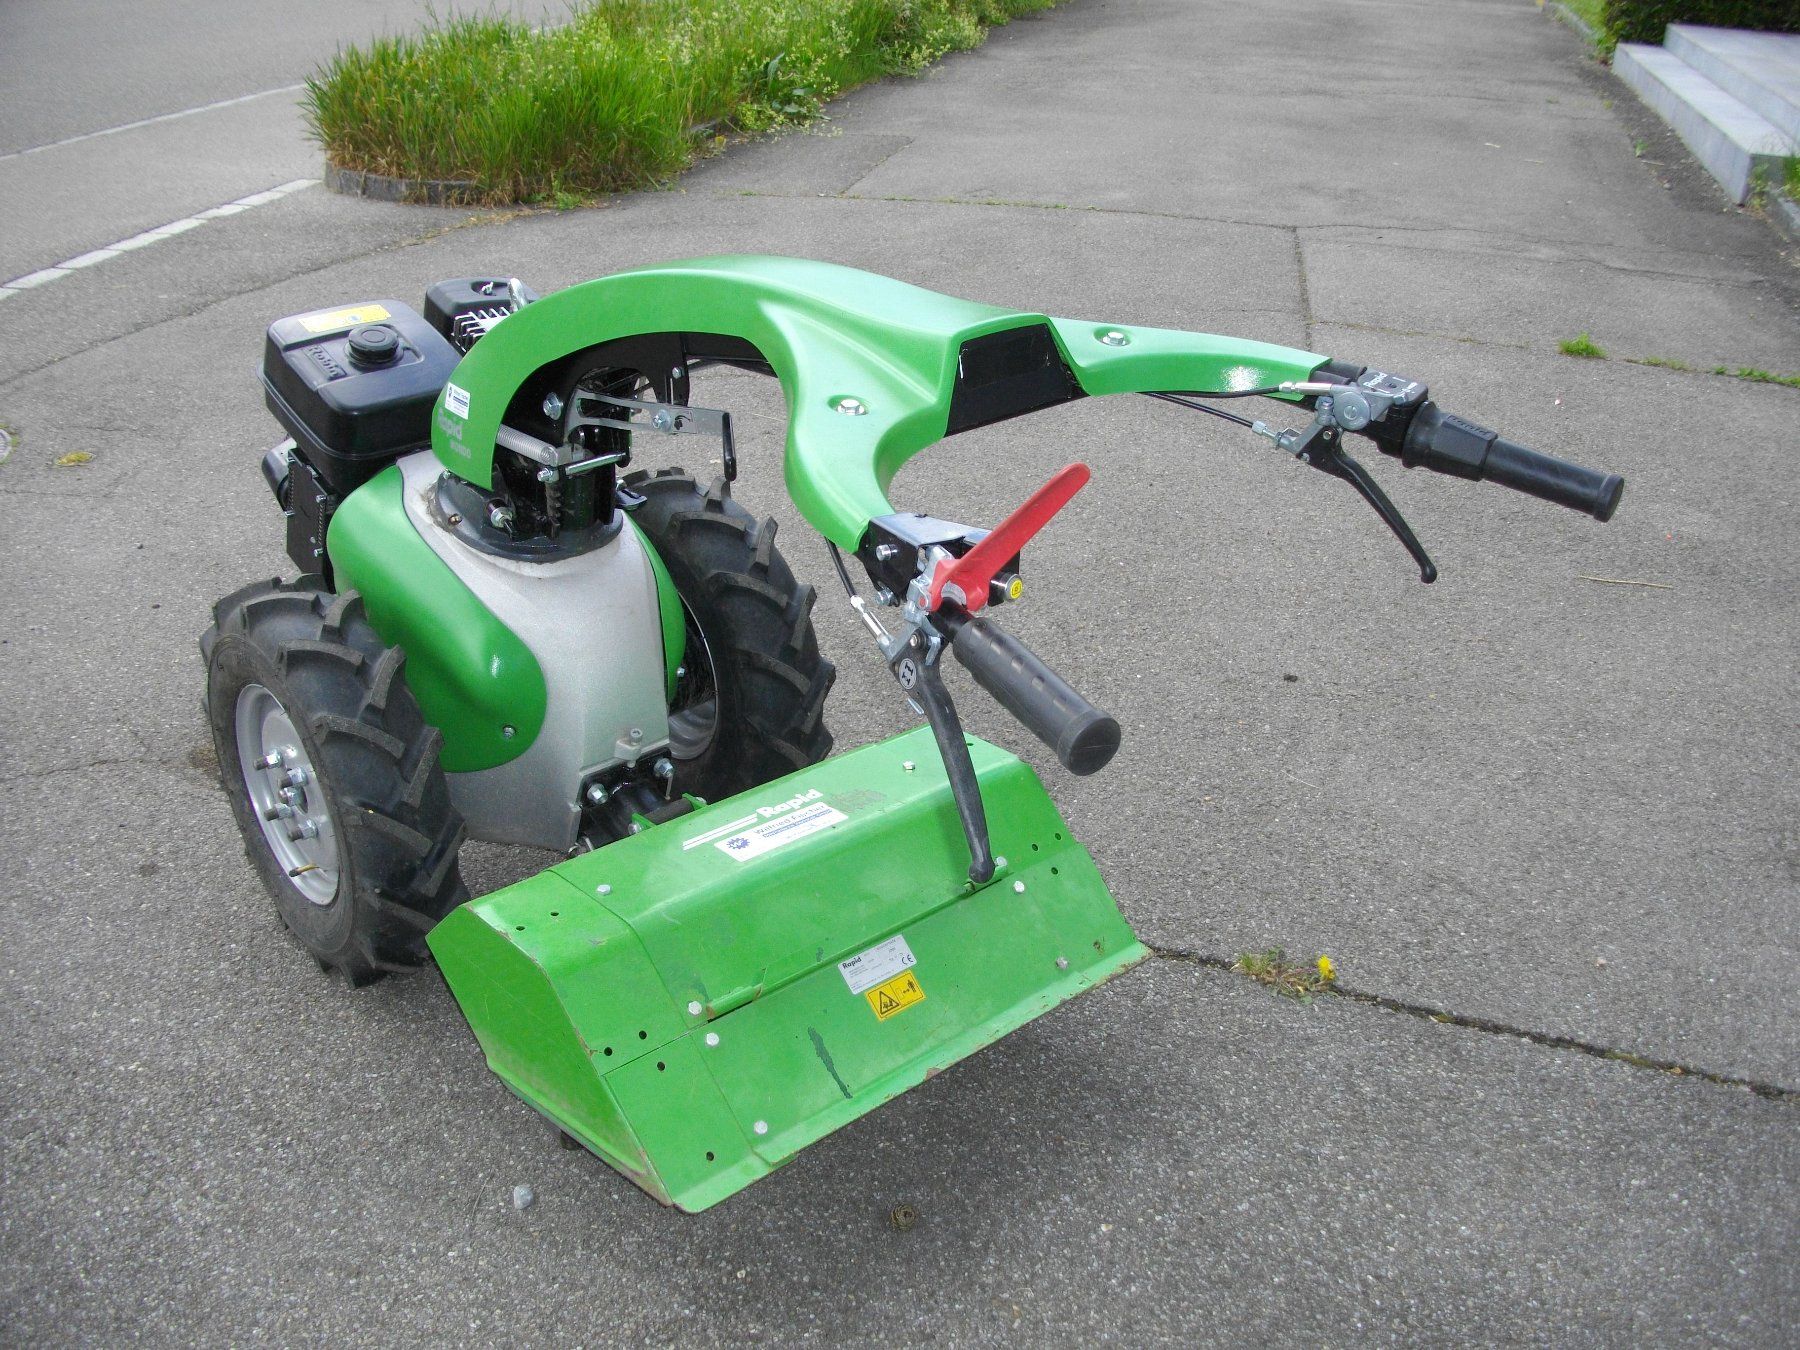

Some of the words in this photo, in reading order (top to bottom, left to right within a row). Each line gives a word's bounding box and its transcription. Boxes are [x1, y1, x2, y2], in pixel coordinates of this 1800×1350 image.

[308, 345, 341, 377] Robin
[1363, 372, 1387, 387] Rapid
[756, 788, 823, 818] Rapid
[842, 956, 862, 969] Rapid
